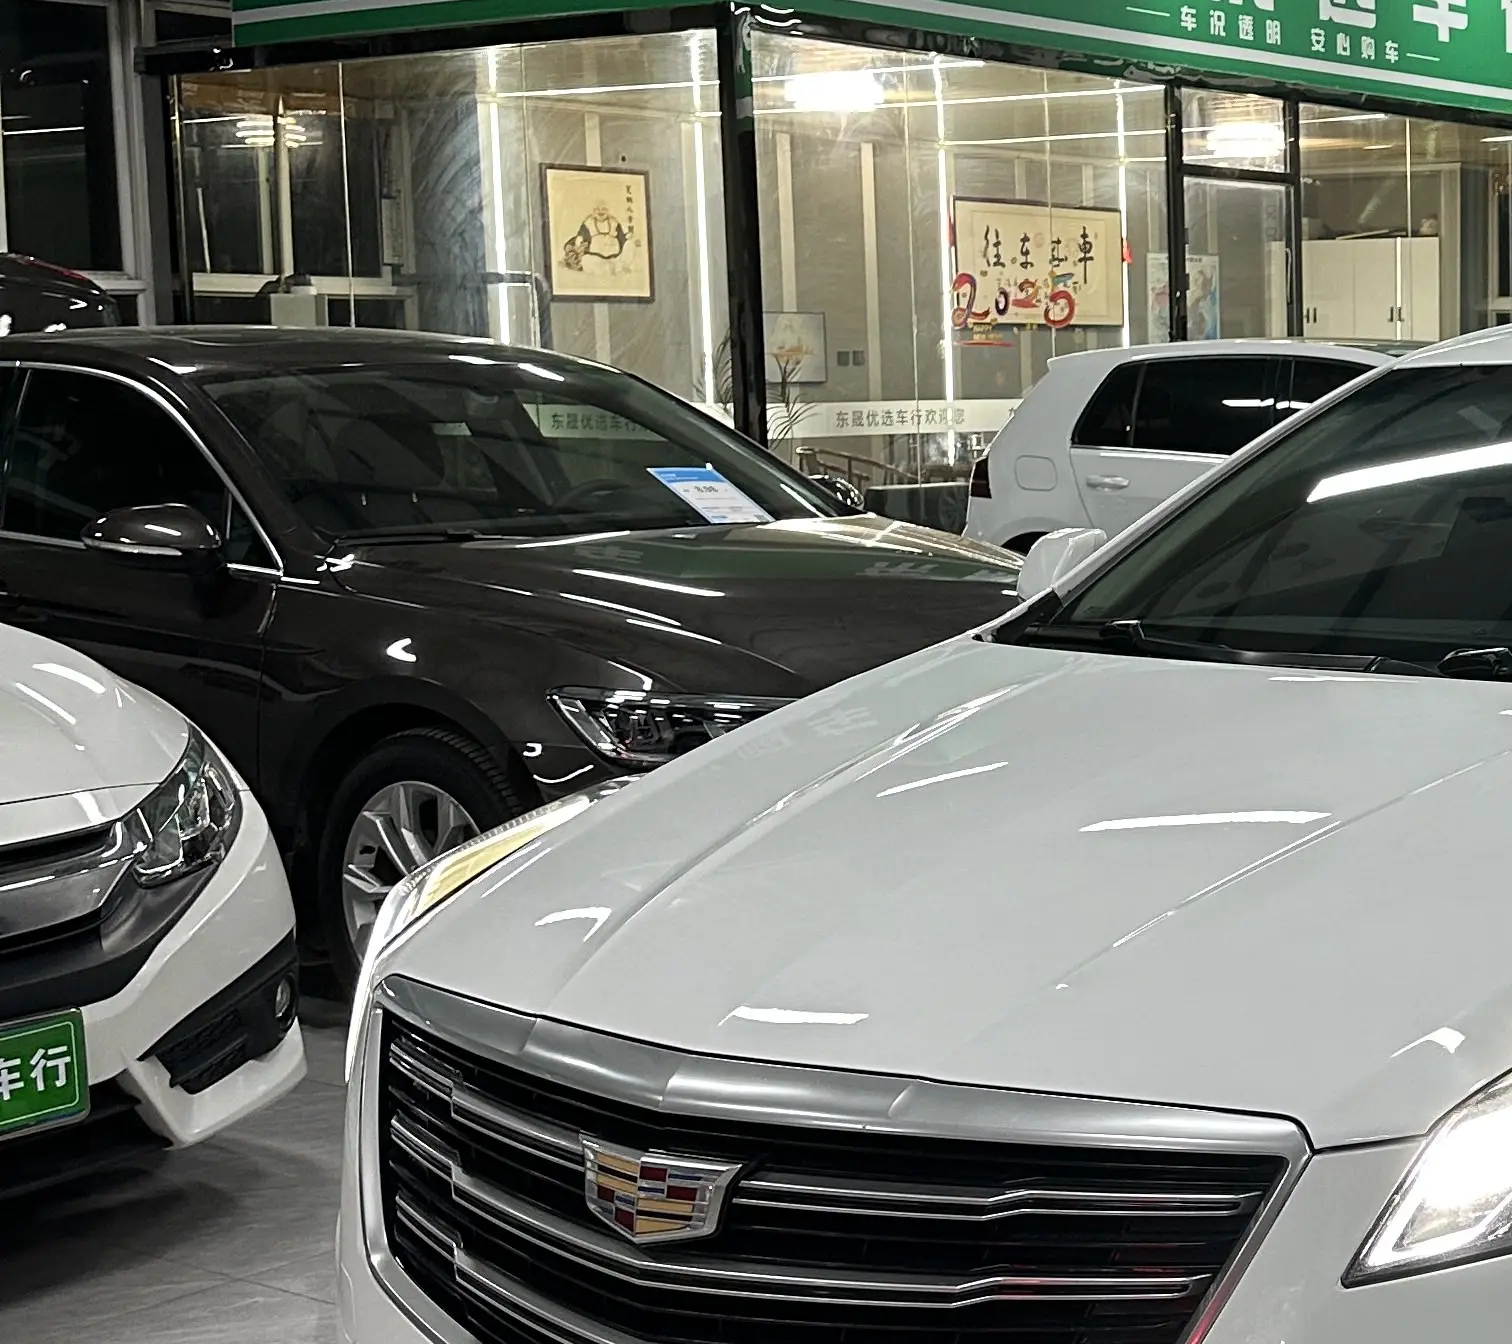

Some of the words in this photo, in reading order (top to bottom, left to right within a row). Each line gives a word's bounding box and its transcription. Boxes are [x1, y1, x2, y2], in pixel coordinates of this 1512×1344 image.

[1180, 5, 1282, 45] 车况透明
[1311, 27, 1399, 64] 安心购车
[551, 412, 646, 433] 东晟优选车行
[0, 1045, 71, 1101] 车行
